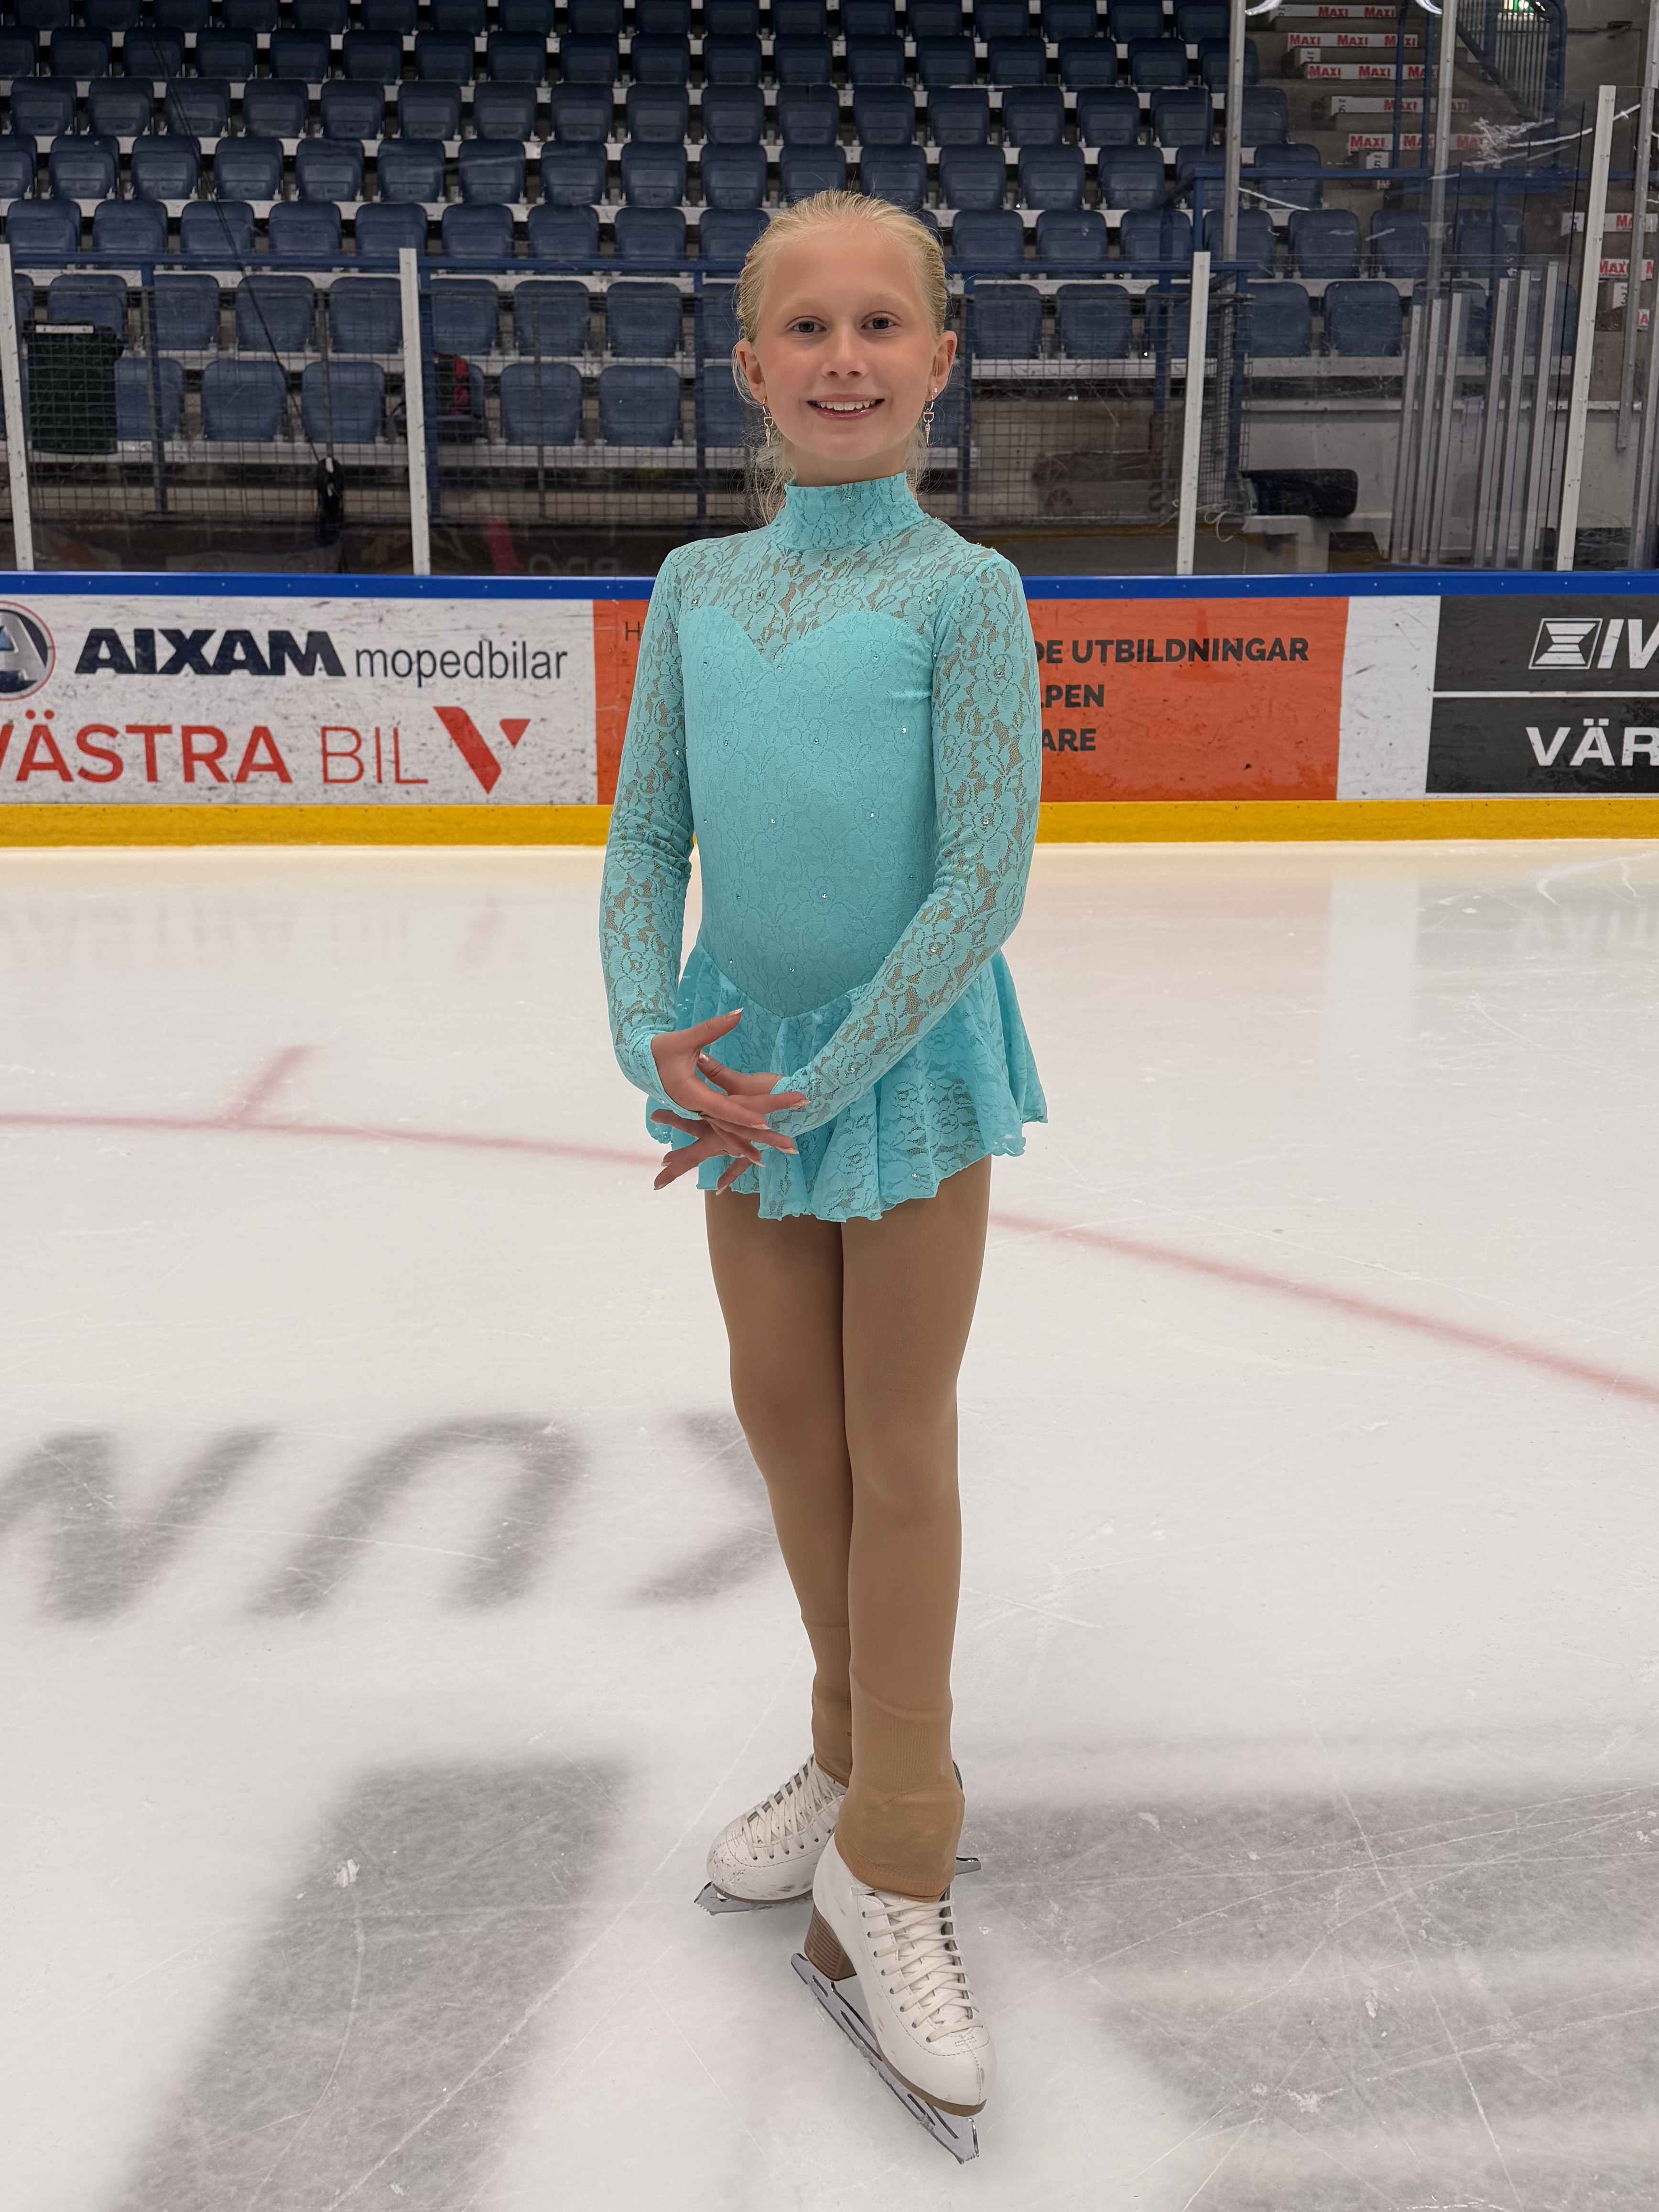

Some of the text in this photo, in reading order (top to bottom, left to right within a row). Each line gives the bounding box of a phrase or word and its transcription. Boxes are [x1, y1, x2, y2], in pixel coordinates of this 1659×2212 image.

[1290, 34, 1416, 46] MAXI MAXI MXI
[1359, 65, 1390, 77] MAXI
[1350, 136, 1385, 147] MAXI
[75, 627, 568, 687] AIXAM mopedbilar
[1072, 637, 1309, 663] UTBILDNINGAR
[1041, 684, 1105, 708] PEN
[321, 726, 429, 784] BIL
